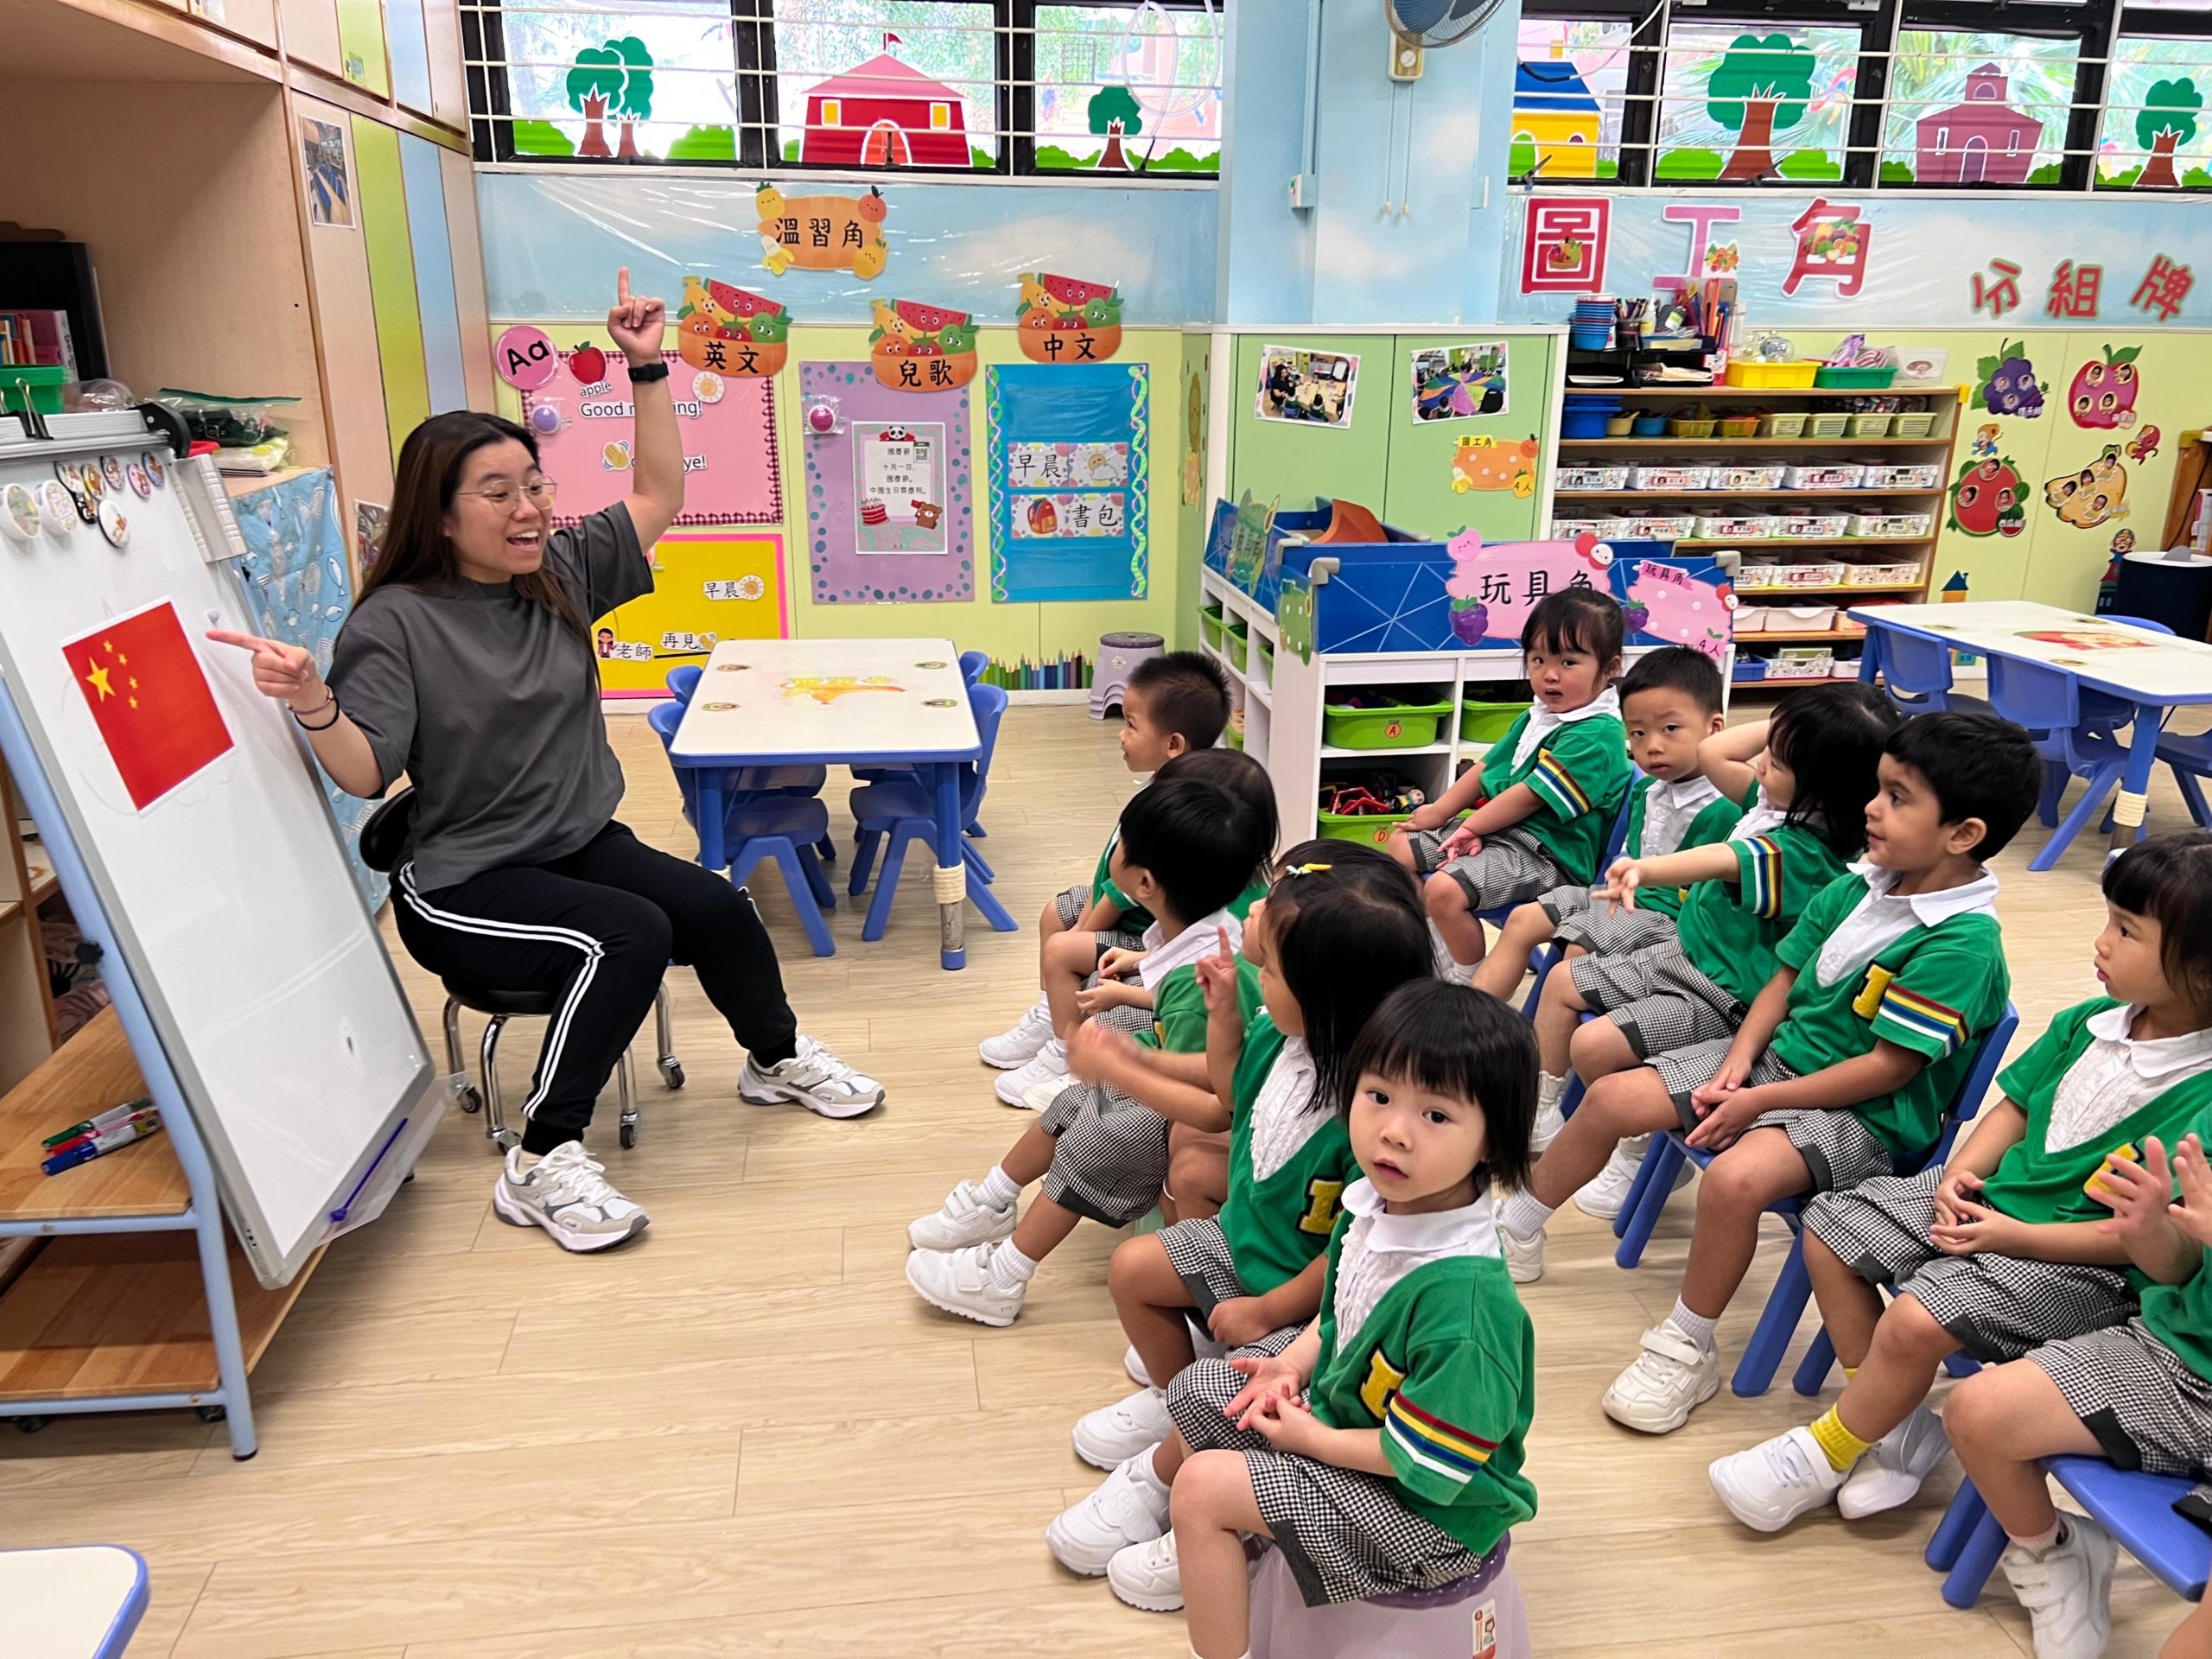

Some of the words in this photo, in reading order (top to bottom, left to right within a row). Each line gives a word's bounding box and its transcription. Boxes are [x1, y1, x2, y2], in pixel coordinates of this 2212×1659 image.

[774, 218, 863, 249] 溫習角
[1522, 198, 1872, 296] 圖工角
[1973, 255, 2194, 322] 分組牌
[704, 341, 760, 374] 英文
[1042, 332, 1096, 360] 中文
[507, 340, 550, 376] Aa
[899, 359, 954, 388] 兒歌
[580, 382, 612, 397] apple
[581, 402, 623, 416] Good
[1015, 454, 1062, 479] 早晨
[1514, 481, 1532, 492] 4人
[1072, 505, 1118, 528] 書包
[1646, 563, 1683, 585] 玩具角
[704, 582, 740, 598] 早晨
[616, 644, 652, 660] 老師
[662, 632, 698, 650] 再見
[1699, 639, 1719, 657] 4人
